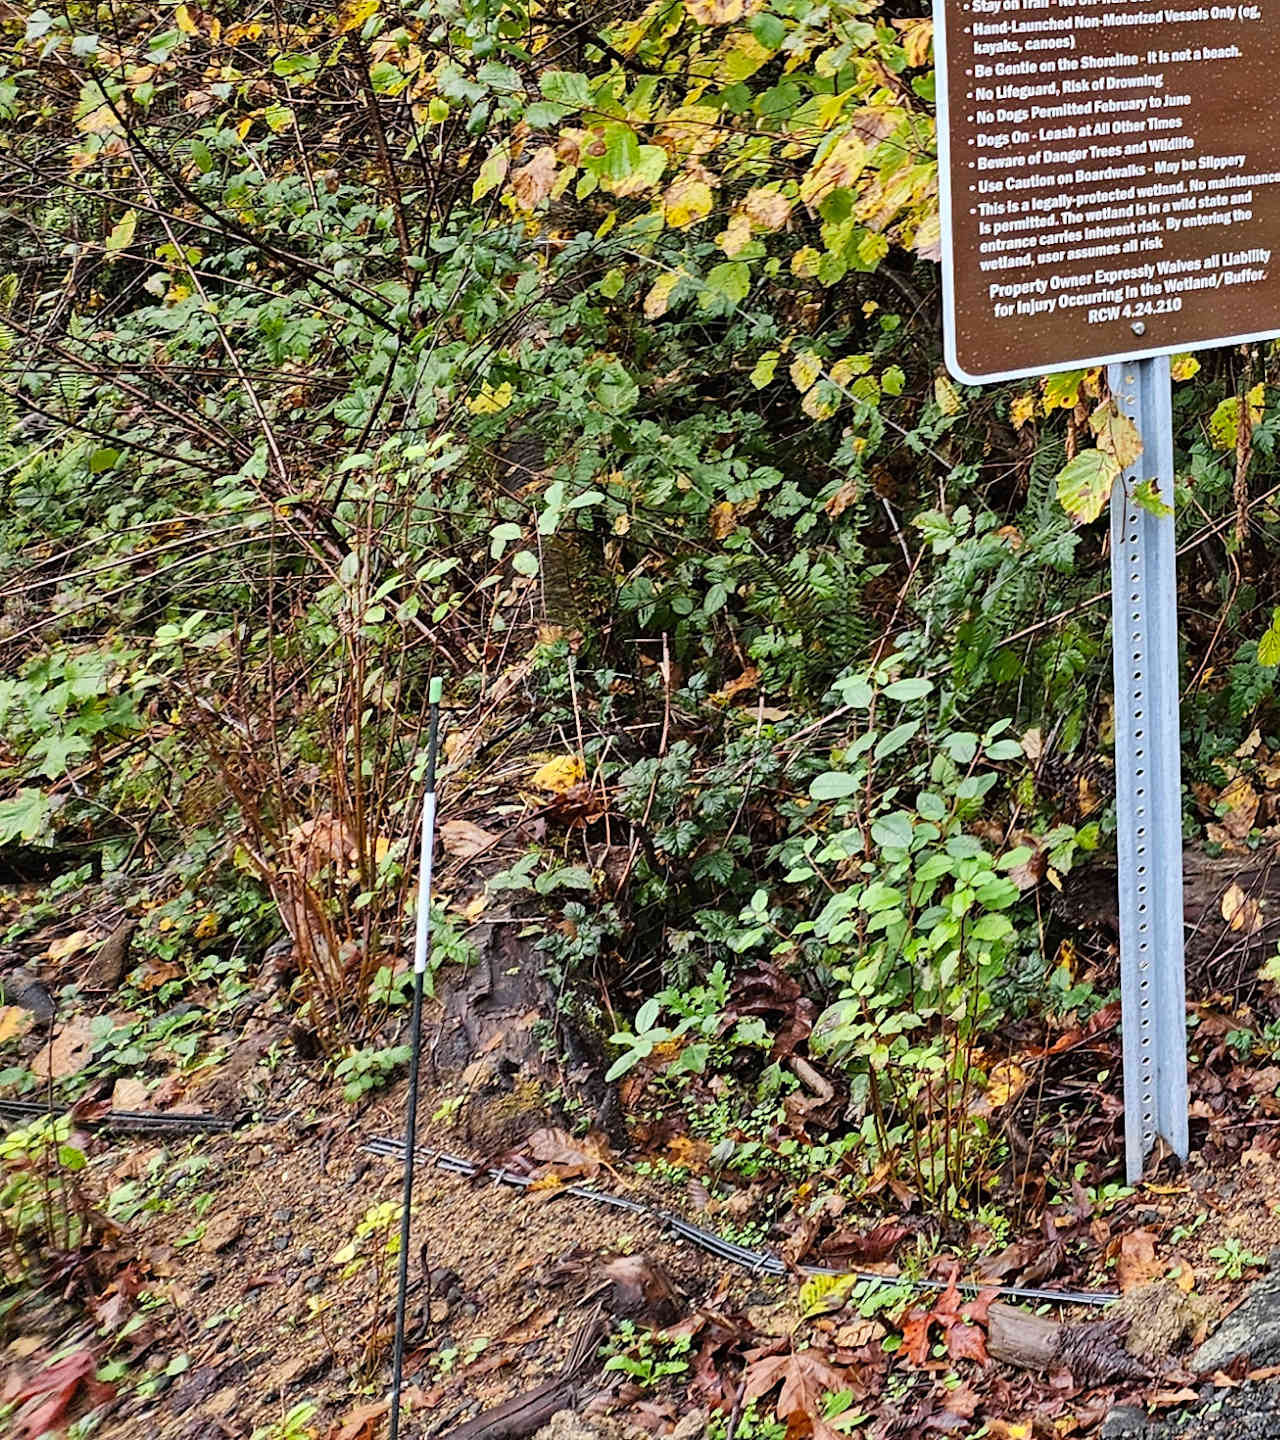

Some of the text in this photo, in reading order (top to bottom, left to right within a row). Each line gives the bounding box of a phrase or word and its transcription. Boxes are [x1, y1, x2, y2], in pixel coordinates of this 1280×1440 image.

[972, 16, 1072, 35] Hand-Launched
[1074, 11, 1163, 28] Non-Motorized
[1164, 9, 1209, 22] Vessels
[1210, 7, 1236, 20] Only
[1002, 0, 1019, 10] on
[973, 34, 1075, 56] kayaks, canoes)
[974, 64, 992, 77] Be
[994, 60, 1037, 75] Gentle
[1039, 61, 1055, 72] on
[1057, 57, 1078, 71] the
[1080, 52, 1138, 69] Shoreline
[1147, 50, 1157, 64] It
[1158, 49, 1169, 62] is
[1171, 48, 1191, 61] not
[1192, 49, 1201, 60] a
[1202, 44, 1242, 59] beach.
[975, 73, 1163, 100] No Lifeguard, Risk of Drowning
[976, 94, 1191, 123] No Dogs Permitted February to June
[976, 133, 1009, 148] Dogs
[1011, 130, 1029, 143] On
[1038, 125, 1076, 140] Leash
[1078, 124, 1091, 137] at
[1092, 121, 1110, 135] All
[1111, 120, 1145, 133] Other
[1146, 117, 1182, 130] Times
[977, 136, 1193, 169] Beware of Danger Trees and Wildlife
[978, 179, 1003, 193] Use
[1004, 174, 1055, 190] Caution
[1056, 173, 1073, 184] on
[1075, 164, 1145, 183] Boardwalks
[1154, 160, 1179, 174] May
[1181, 159, 1196, 170] be
[1198, 154, 1245, 169] Slippery
[977, 172, 1280, 216] This is a legally-protected wetland. No maintenance
[979, 189, 1252, 235] is permitted. The wetland is in a wild state and
[979, 208, 1252, 252] entrance carries inherent risk. By entering the
[979, 235, 1163, 271] wetland, user assumes all risk
[989, 249, 1270, 299] Property Owner Expressly Waives all Liability
[993, 303, 1015, 317] for
[1016, 298, 1056, 315] Injury
[1058, 287, 1123, 308] Occurring
[1125, 285, 1138, 298] in
[1139, 282, 1162, 296] the
[1088, 297, 1181, 323] RCW 4.24.210
